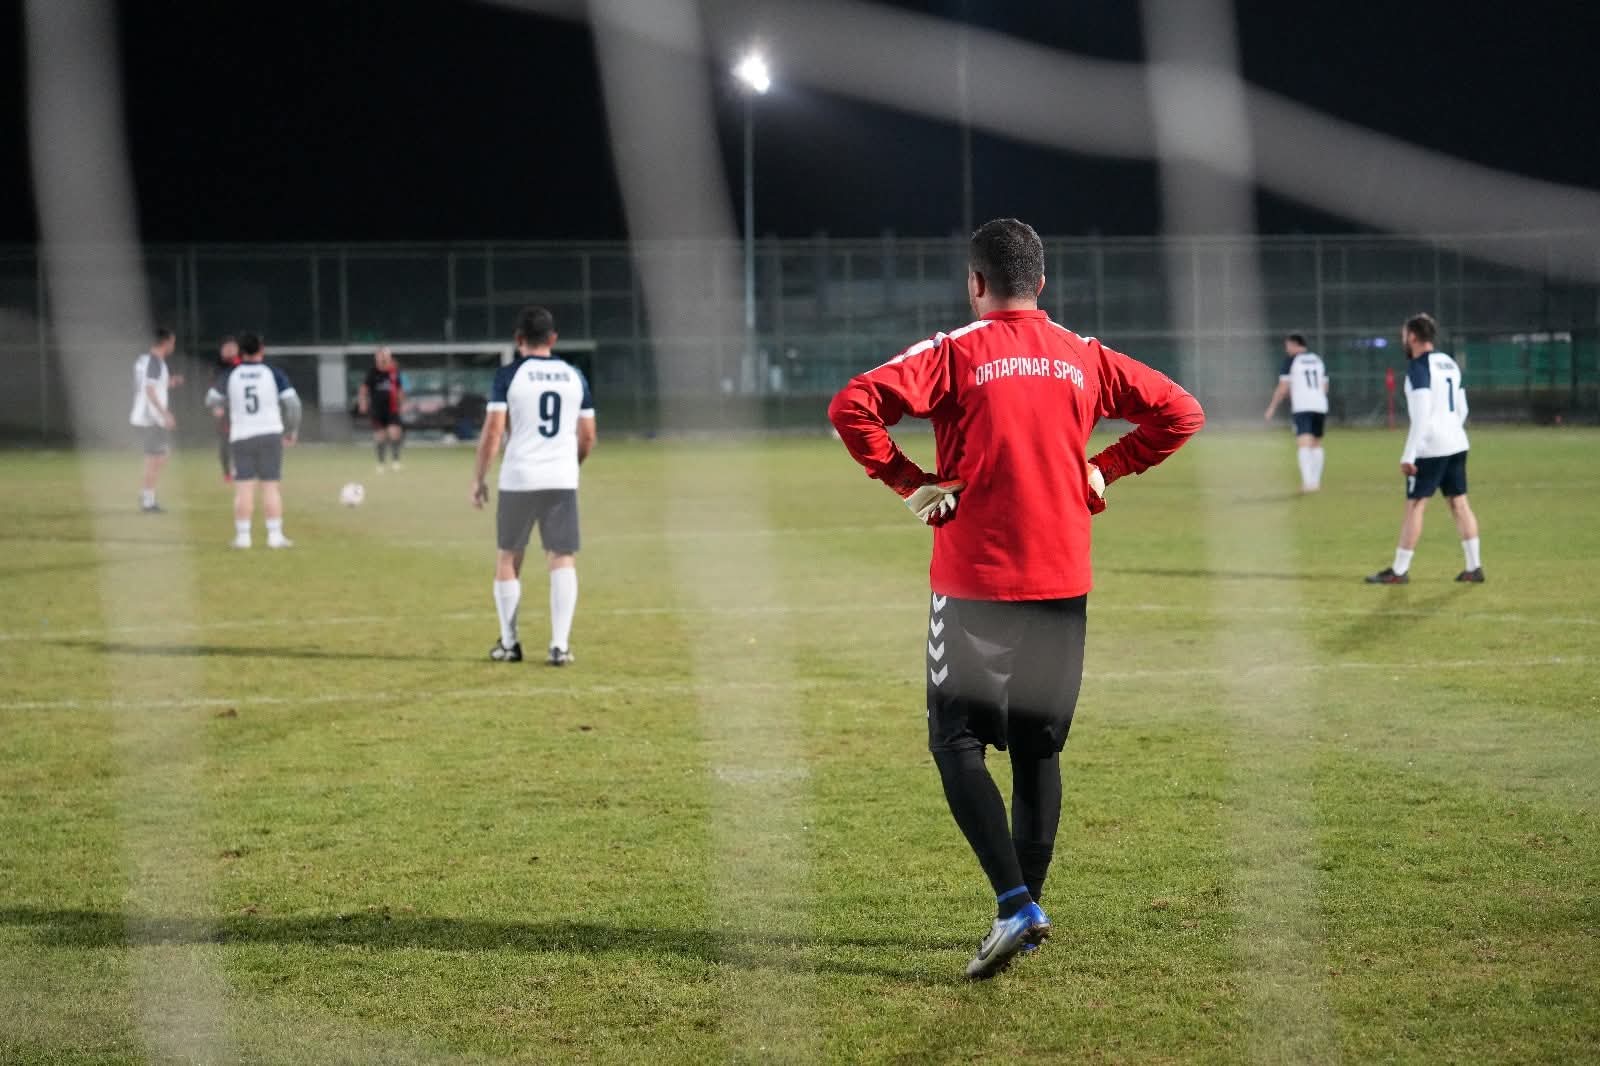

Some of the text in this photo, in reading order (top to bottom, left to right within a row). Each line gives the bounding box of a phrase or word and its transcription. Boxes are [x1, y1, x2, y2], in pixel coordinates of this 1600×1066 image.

[976, 357, 1085, 390] ORTAPINAR SPOR
[1304, 369, 1319, 389] 11
[245, 386, 259, 414] 5
[1446, 377, 1455, 412] 1
[538, 391, 561, 438] 9
